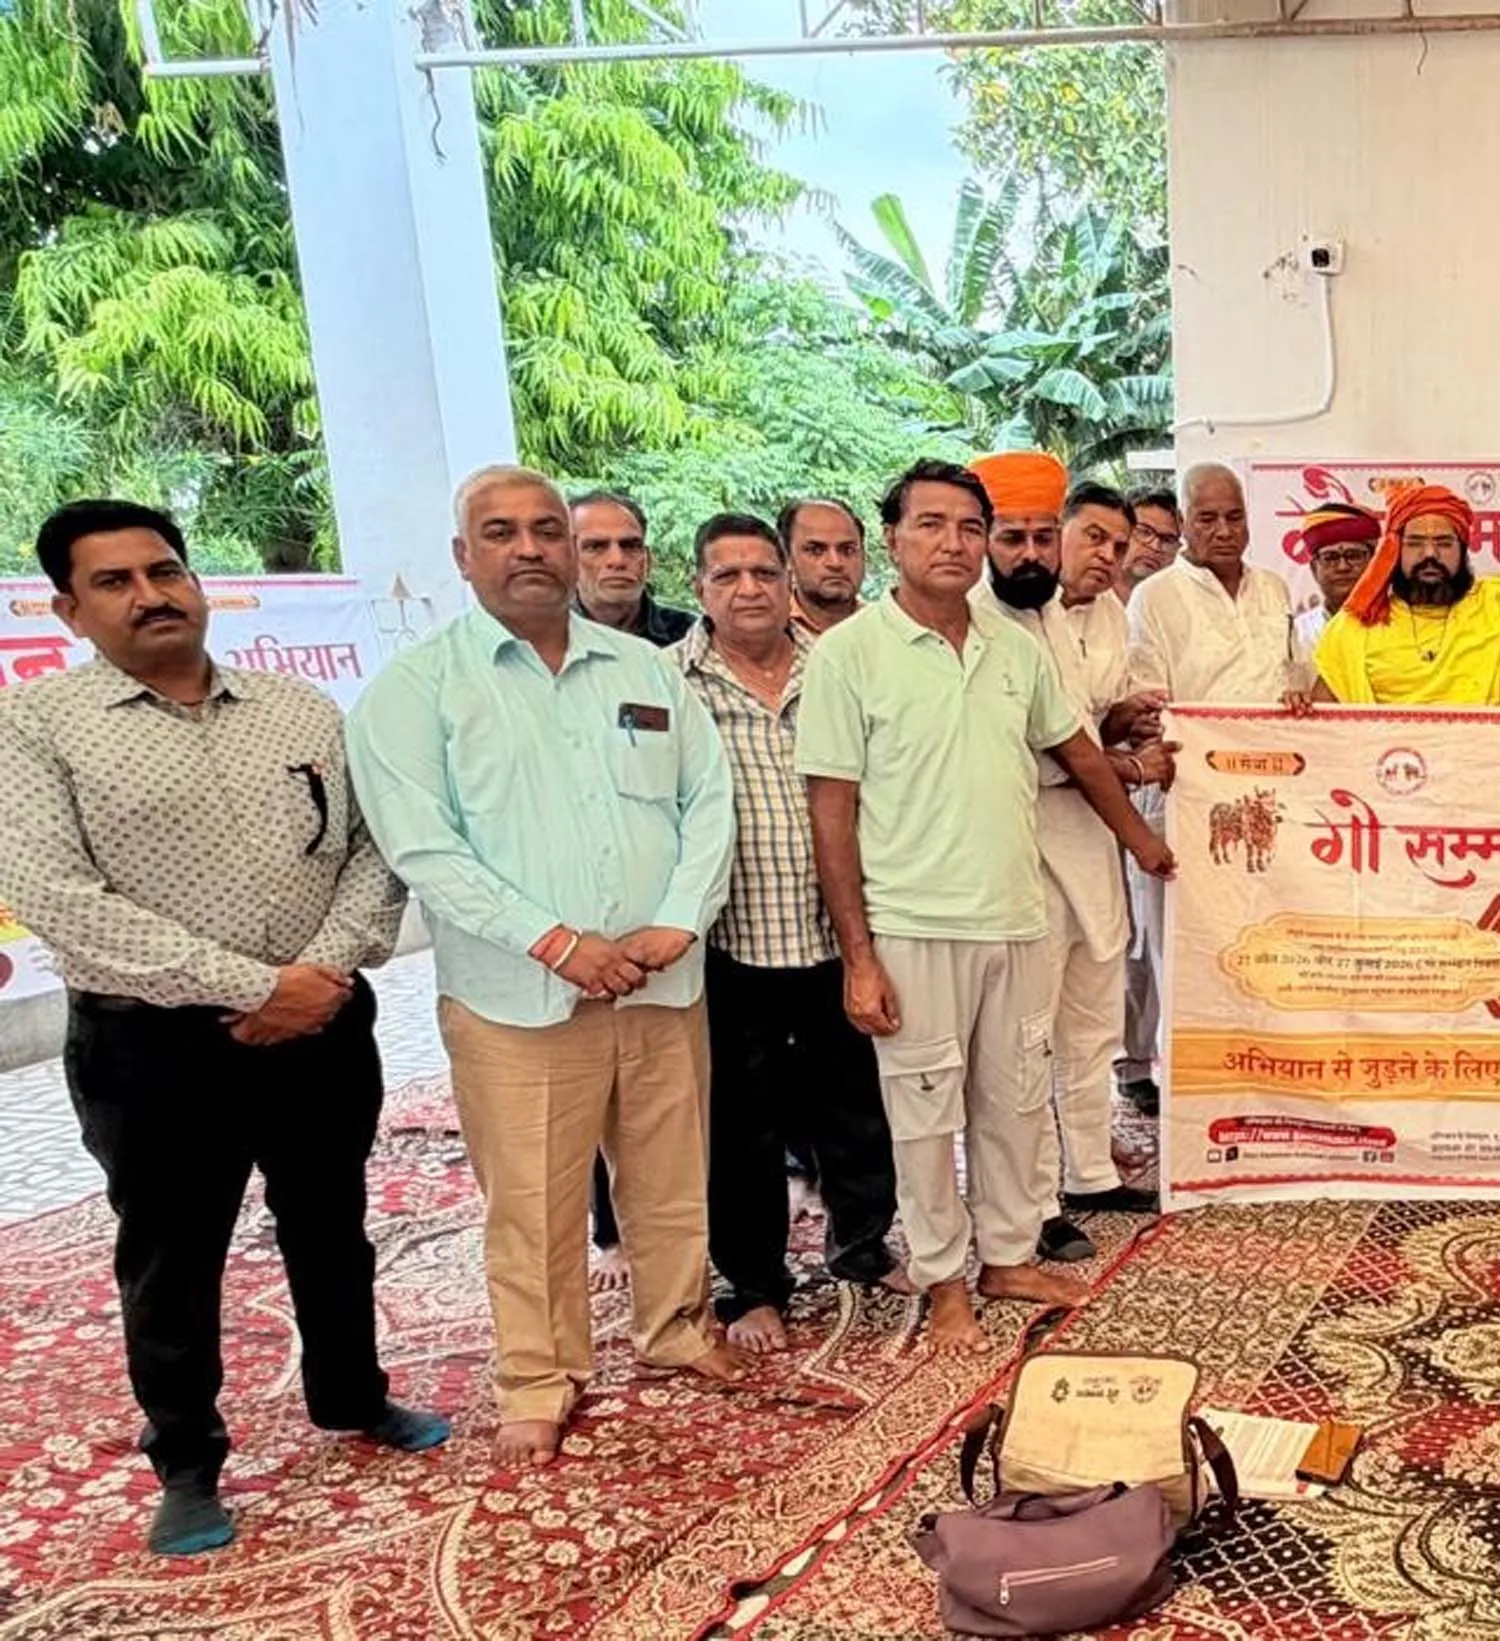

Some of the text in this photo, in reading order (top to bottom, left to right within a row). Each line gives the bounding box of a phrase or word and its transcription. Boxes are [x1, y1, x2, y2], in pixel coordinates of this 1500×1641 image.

[1303, 788, 1388, 874] गौ
[1224, 1046, 1325, 1079] अभियान
[1332, 1050, 1353, 1079] से
[1360, 1051, 1417, 1088] जुड़ने
[1423, 1050, 1449, 1079] के
